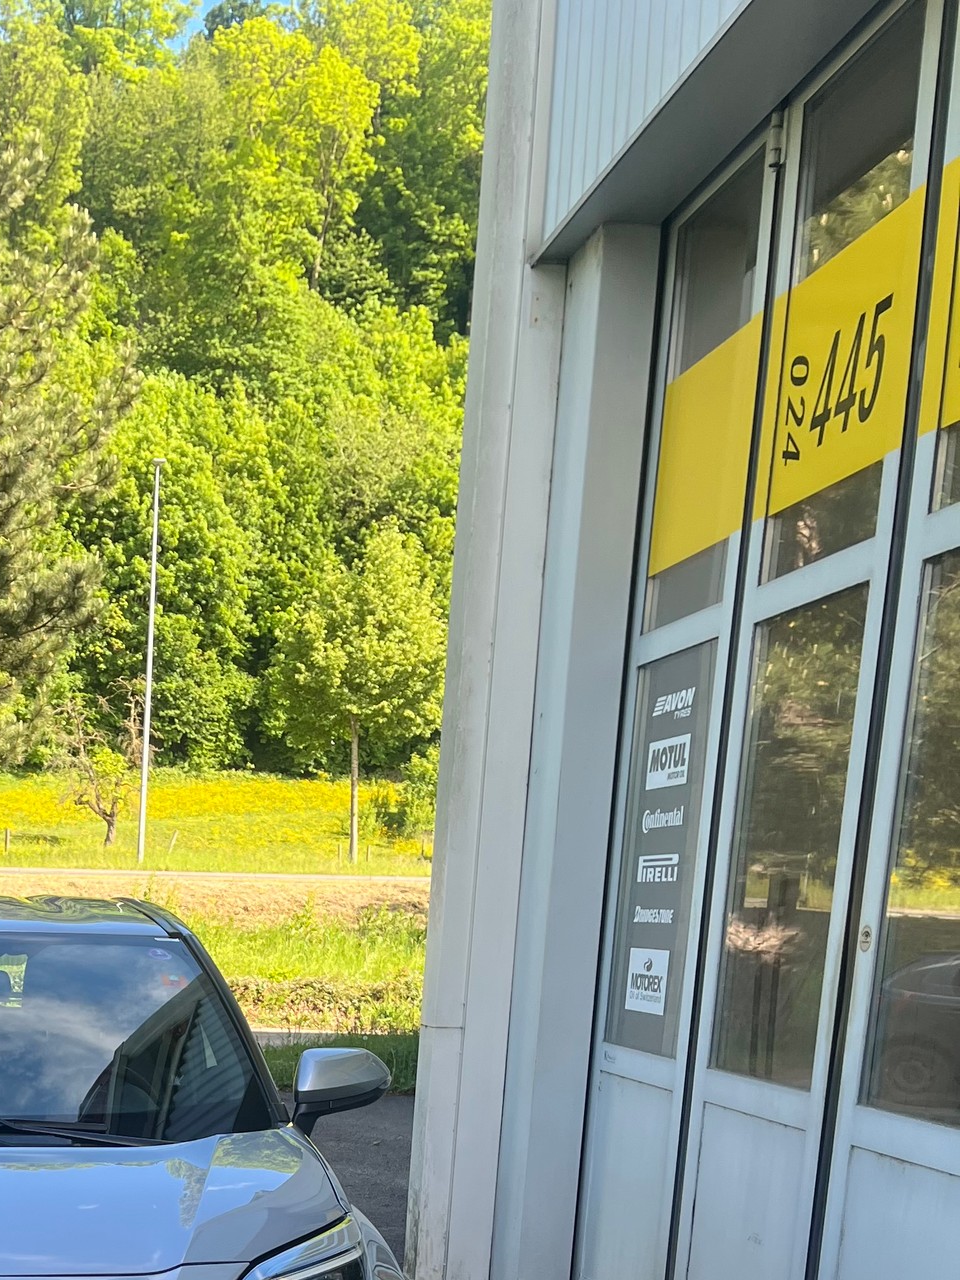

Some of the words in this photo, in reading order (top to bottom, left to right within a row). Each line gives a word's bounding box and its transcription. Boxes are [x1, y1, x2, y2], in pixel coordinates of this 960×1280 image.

[809, 292, 894, 447] 445
[781, 355, 809, 467] 024
[659, 687, 696, 714] AVON
[649, 742, 687, 773] MOTUL
[642, 805, 684, 834] Continental
[637, 853, 679, 882] PIRELLI
[631, 972, 663, 993] MOTOREX
